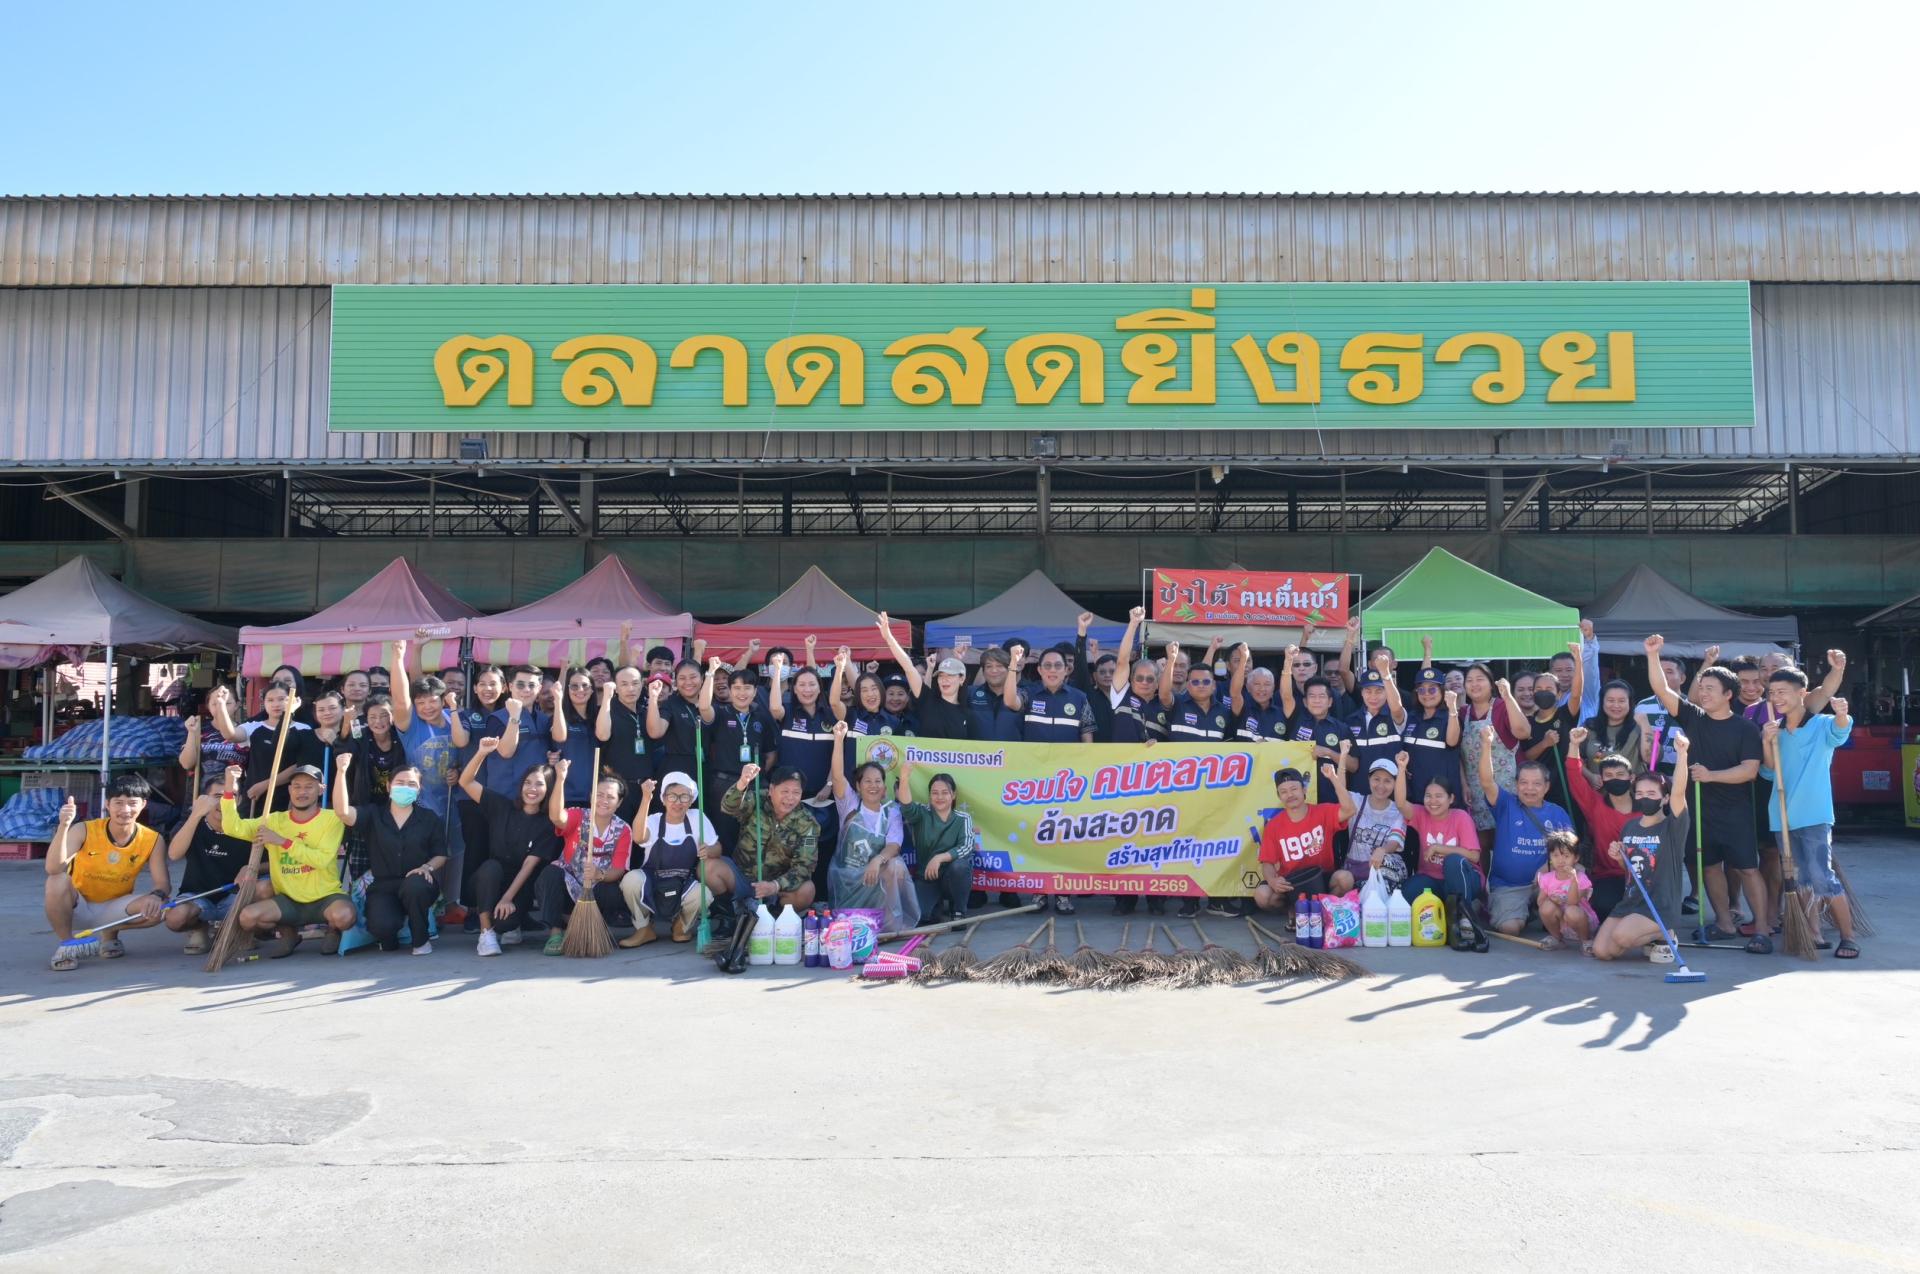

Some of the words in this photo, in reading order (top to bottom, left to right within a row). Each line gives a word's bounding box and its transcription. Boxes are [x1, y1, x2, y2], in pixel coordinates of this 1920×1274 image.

[433, 288, 1637, 407] ตลาดสดยิ่งรวย
[906, 747, 1003, 766] กิจกรรมรณรงค์
[1003, 769, 1086, 805] รวมใจ
[1092, 753, 1252, 798] คนตลาด
[1037, 808, 1175, 842] ล้างสะอาด
[1108, 838, 1239, 868] สร้างสุขให้ทุกคน
[1054, 874, 1144, 892] ปีงบประมาณ
[1149, 879, 1188, 892] 2569
